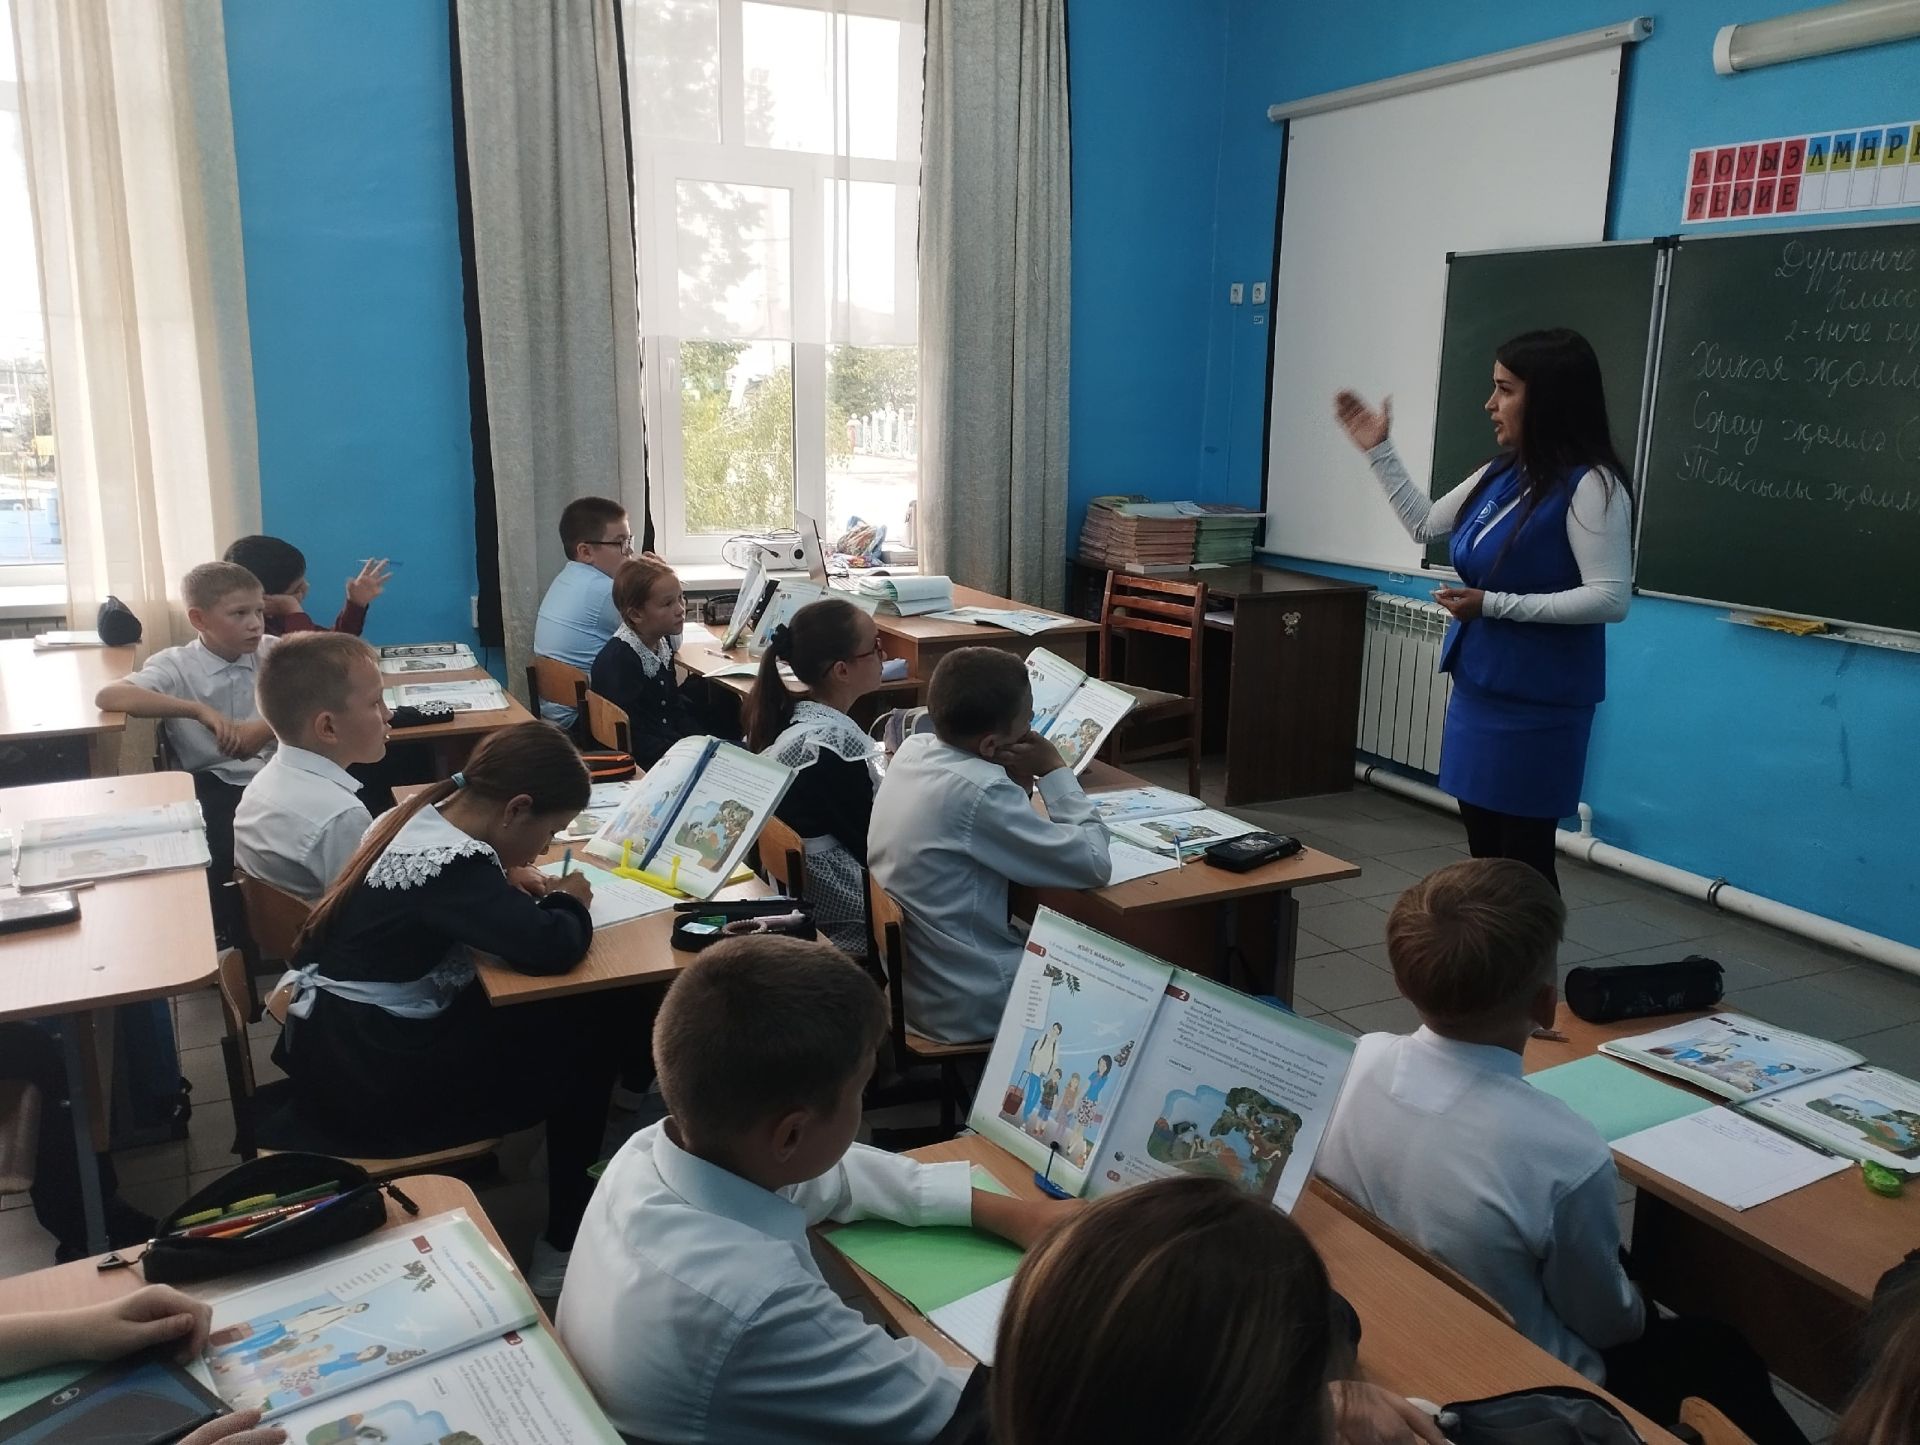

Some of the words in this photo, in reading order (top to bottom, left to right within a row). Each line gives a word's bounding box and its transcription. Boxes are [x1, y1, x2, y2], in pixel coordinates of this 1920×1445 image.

[1695, 158, 1709, 179] А
[1717, 154, 1732, 176] О
[1740, 151, 1755, 174] У
[1761, 148, 1780, 171] Ы
[1785, 146, 1801, 169] Э
[1833, 141, 1851, 163] М
[1860, 137, 1877, 161] Н
[1887, 134, 1904, 158] Р
[1691, 192, 1704, 214] Я
[1733, 188, 1752, 210] Ю
[1757, 185, 1771, 208] И
[1781, 183, 1795, 205] Е
